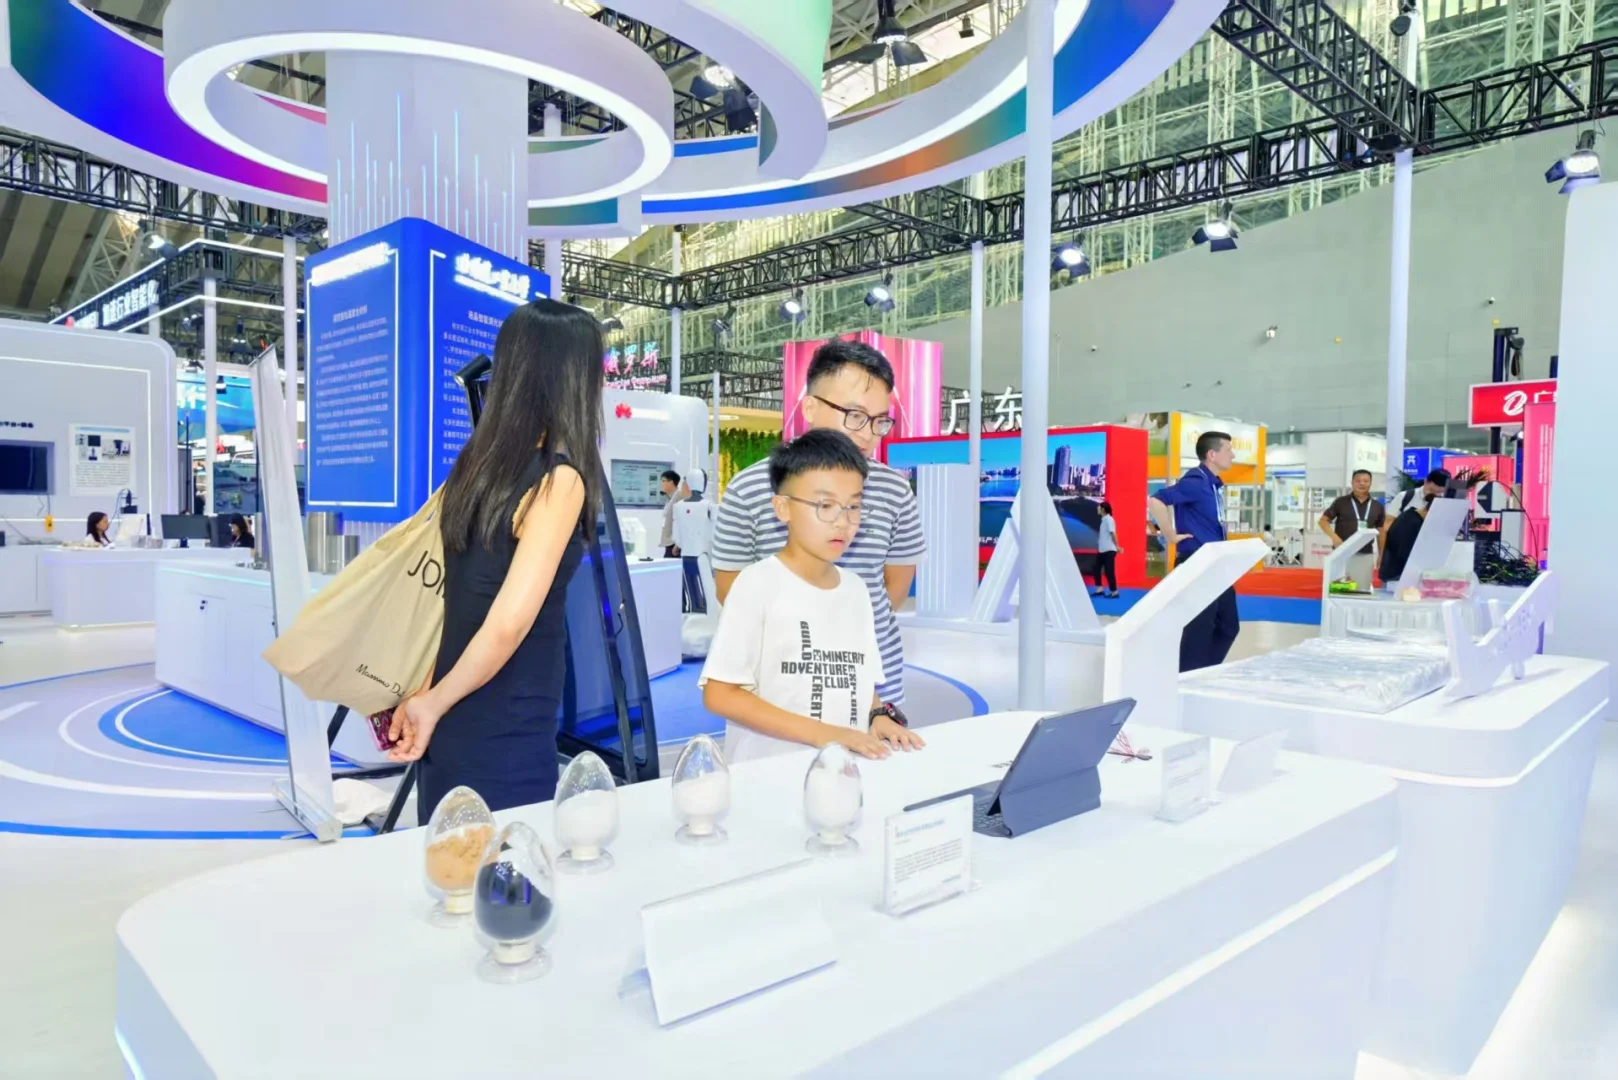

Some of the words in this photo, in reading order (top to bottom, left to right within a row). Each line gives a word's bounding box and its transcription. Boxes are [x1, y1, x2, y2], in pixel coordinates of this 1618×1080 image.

[800, 620, 812, 661] BUILD
[781, 661, 849, 676] ADVENTURE
[824, 676, 850, 689] CLUB
[848, 664, 858, 726] EXPLORE
